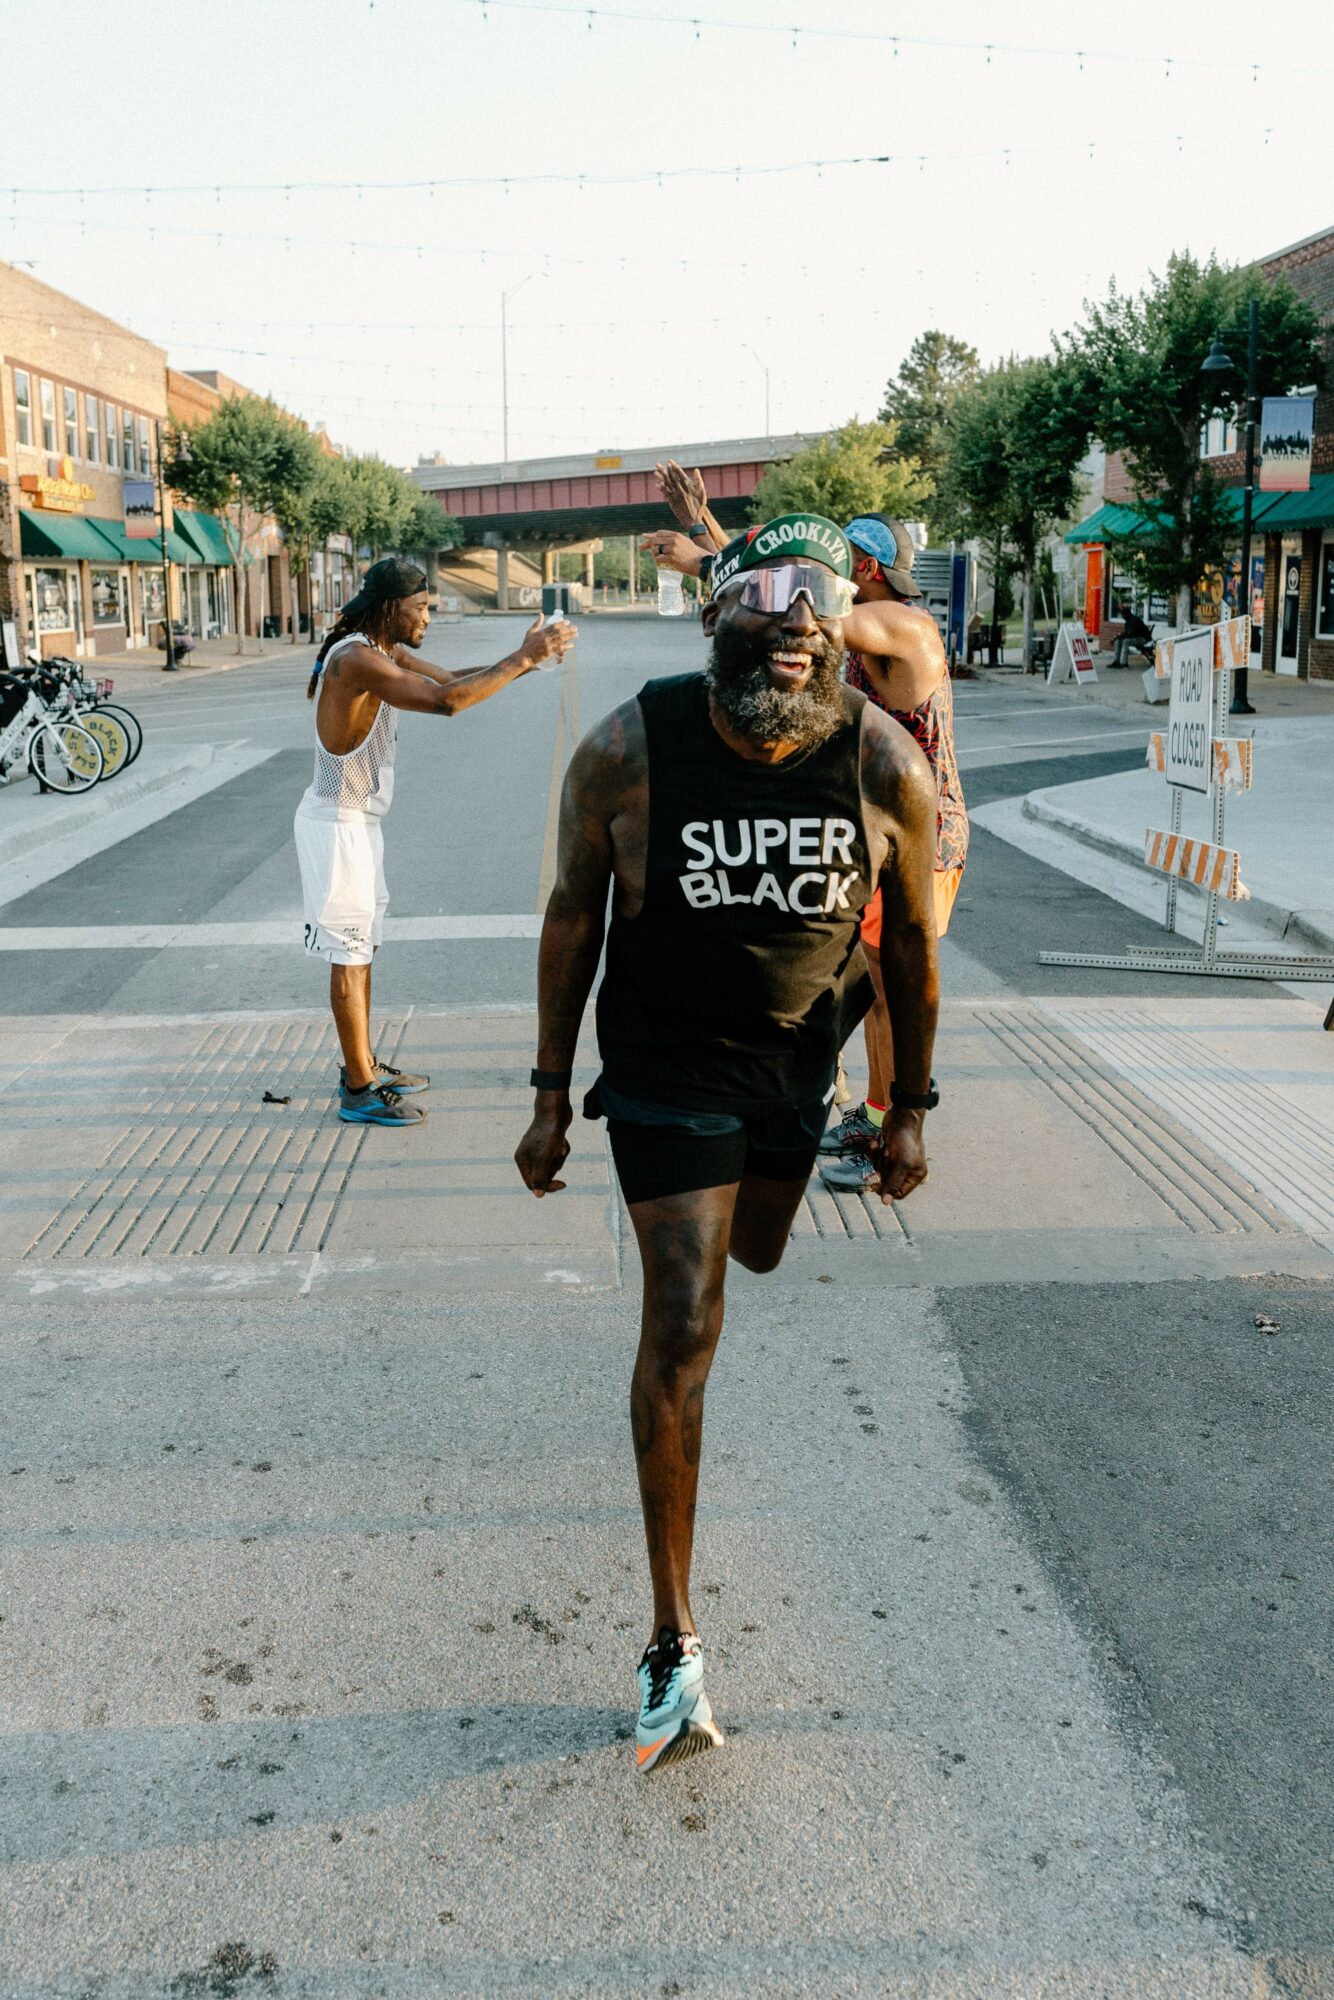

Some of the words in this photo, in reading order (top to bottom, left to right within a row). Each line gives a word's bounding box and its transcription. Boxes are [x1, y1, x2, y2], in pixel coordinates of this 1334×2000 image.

[755, 521, 848, 565] CROOKLYN
[1072, 638, 1089, 657] ATM
[1178, 657, 1204, 704] ROAD
[89, 721, 117, 756] BLACK
[1171, 721, 1206, 769] CLOSED
[681, 817, 857, 870] SUPER
[678, 869, 860, 915] BLACK
